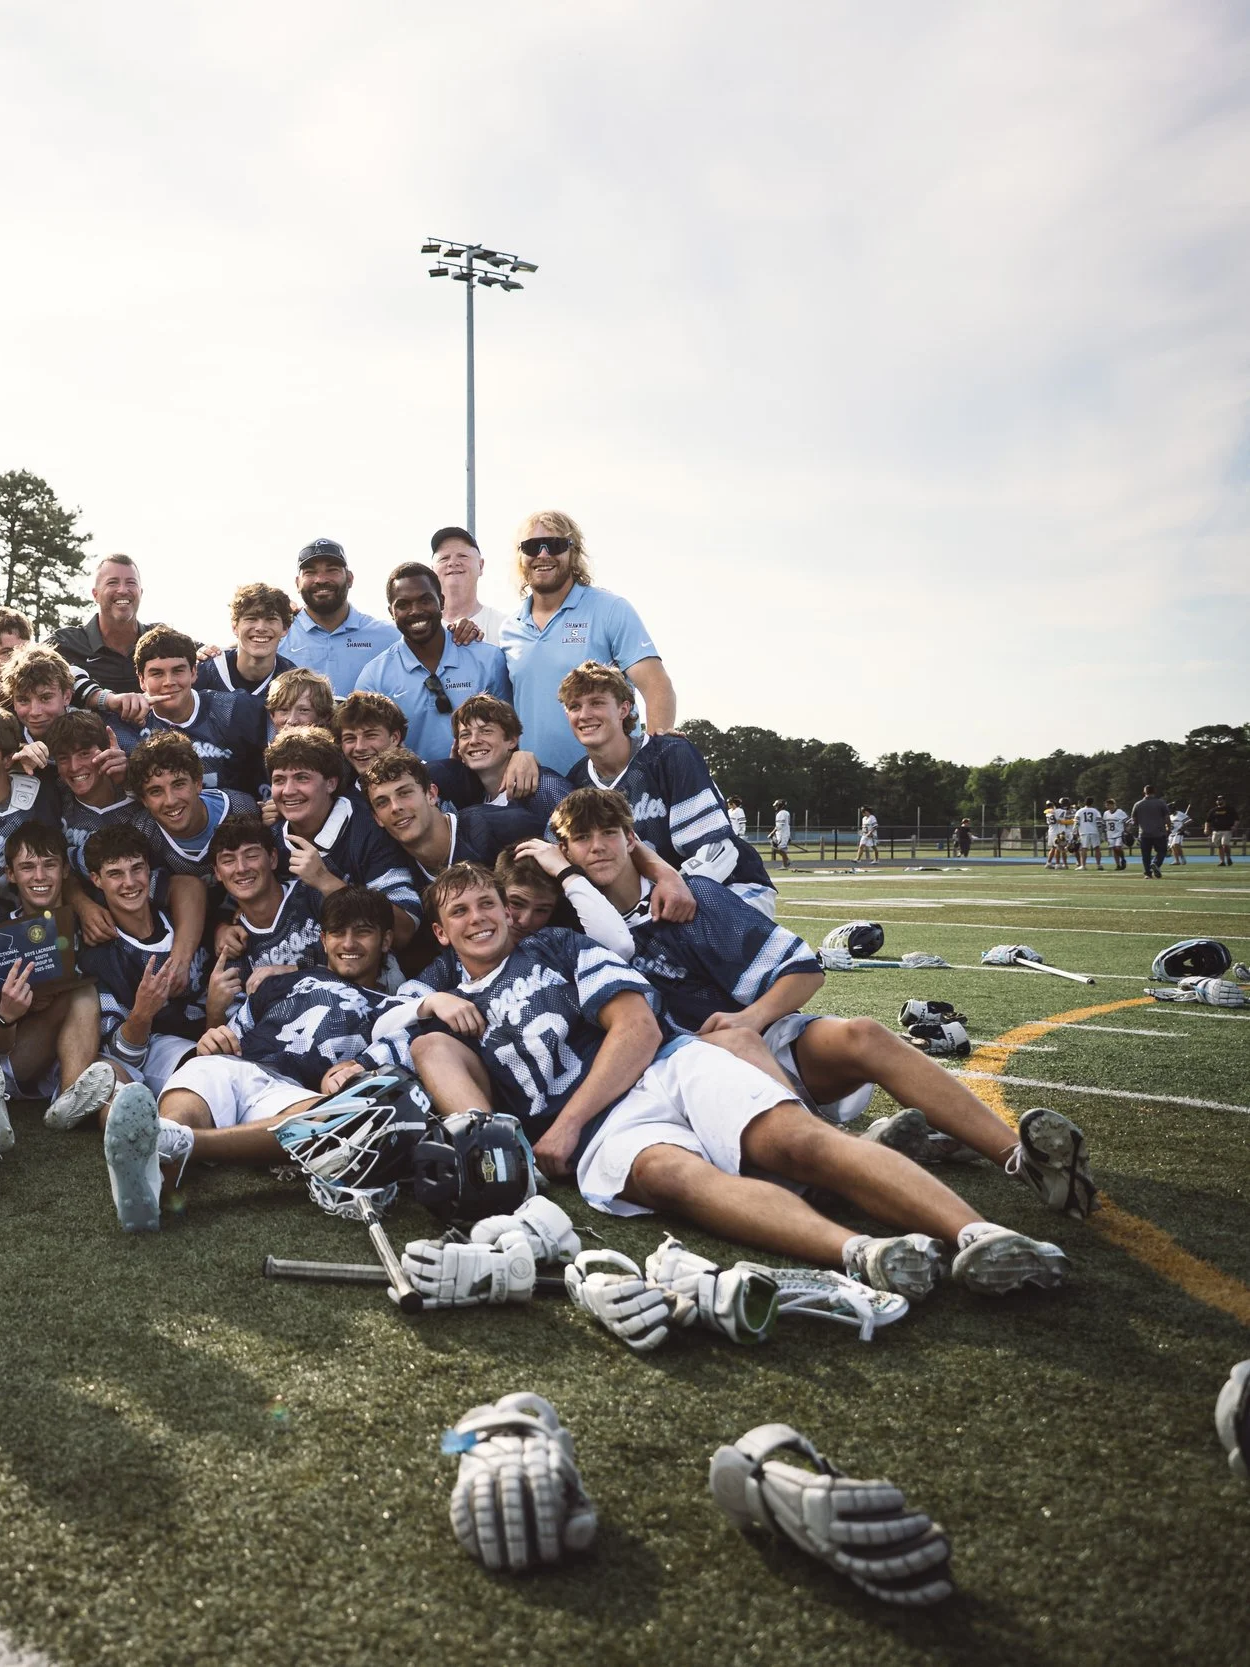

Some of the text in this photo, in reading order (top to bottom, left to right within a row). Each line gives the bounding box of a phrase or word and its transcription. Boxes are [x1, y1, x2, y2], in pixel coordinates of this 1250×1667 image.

[571, 629, 579, 637] S
[445, 681, 472, 690] SHAWNEE
[1083, 811, 1094, 823] 13
[35, 944, 57, 956] LACROSSE
[494, 1011, 583, 1117] 10
[409, 1084, 432, 1115] S
